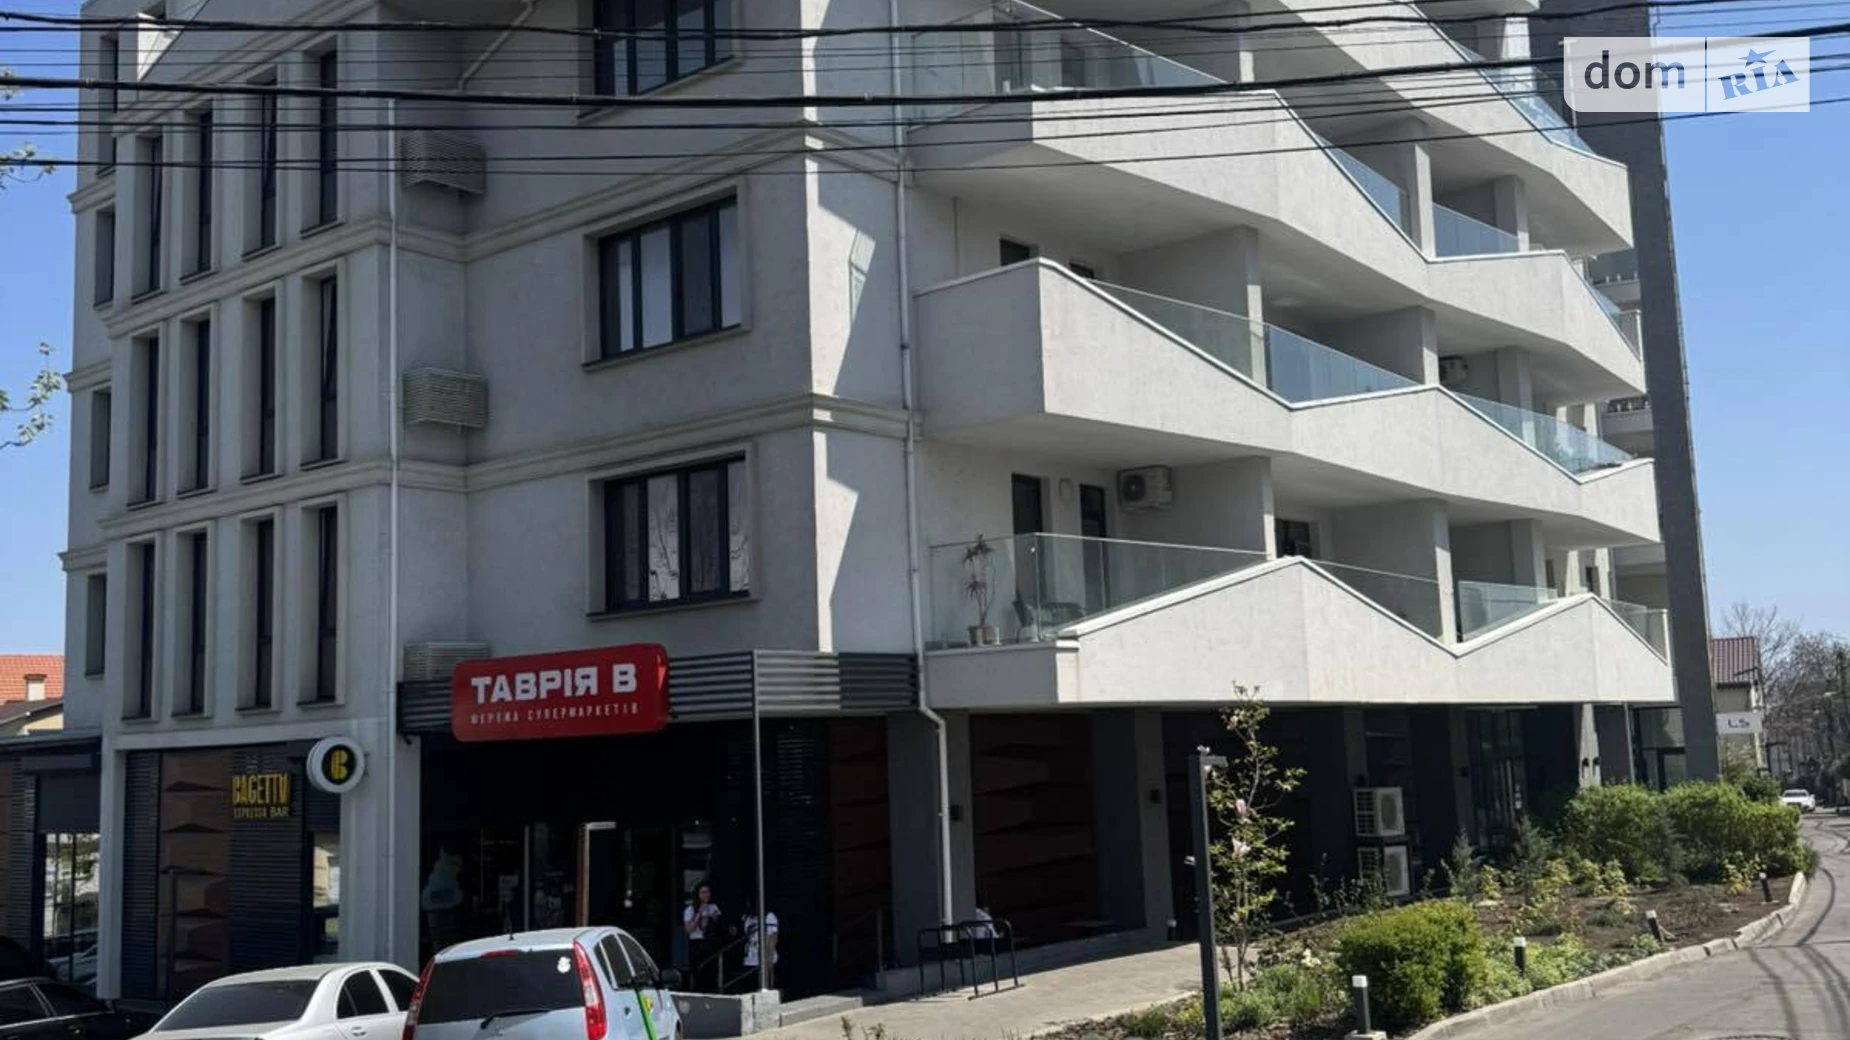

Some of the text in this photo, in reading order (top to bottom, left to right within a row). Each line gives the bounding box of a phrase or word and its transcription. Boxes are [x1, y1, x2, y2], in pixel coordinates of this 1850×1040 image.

[471, 663, 638, 704] ТАВРІЯ В
[270, 806, 290, 818] BAR
